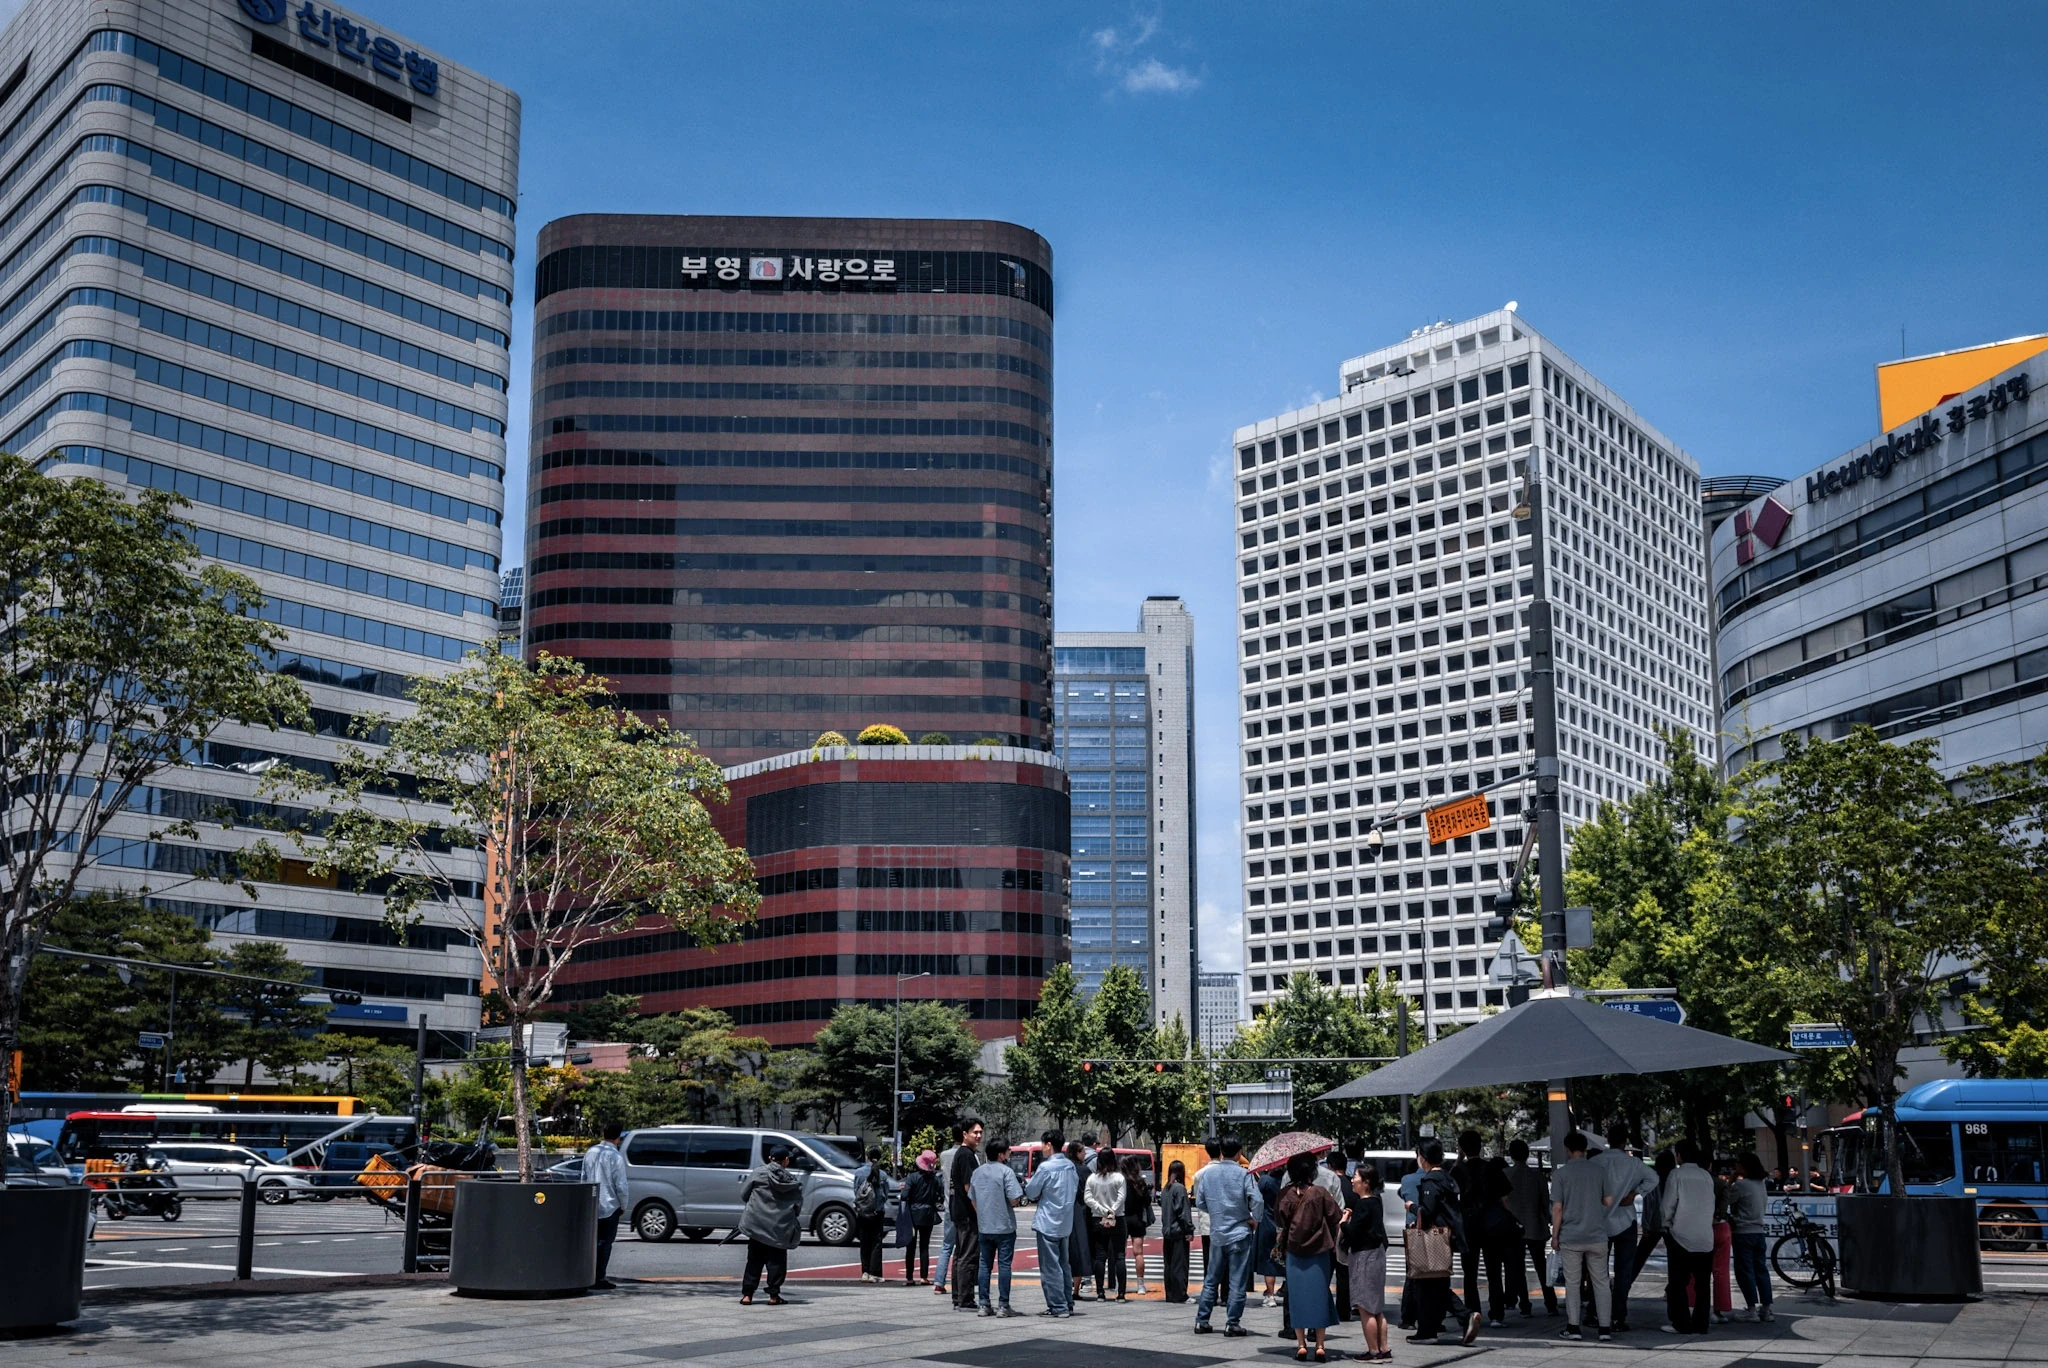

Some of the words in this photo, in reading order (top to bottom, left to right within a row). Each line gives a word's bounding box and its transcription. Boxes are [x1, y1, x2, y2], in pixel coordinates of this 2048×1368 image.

[296, 1, 439, 96] 신한은행
[681, 256, 741, 281] 부영
[788, 257, 897, 283] 사랑으로
[1946, 373, 2030, 433] 흥국생명
[1806, 415, 1942, 504] Heungkuk
[1606, 1004, 1641, 1013] 대문로
[1793, 1032, 1823, 1040] 남대문로
[1965, 1123, 1988, 1135] 968
